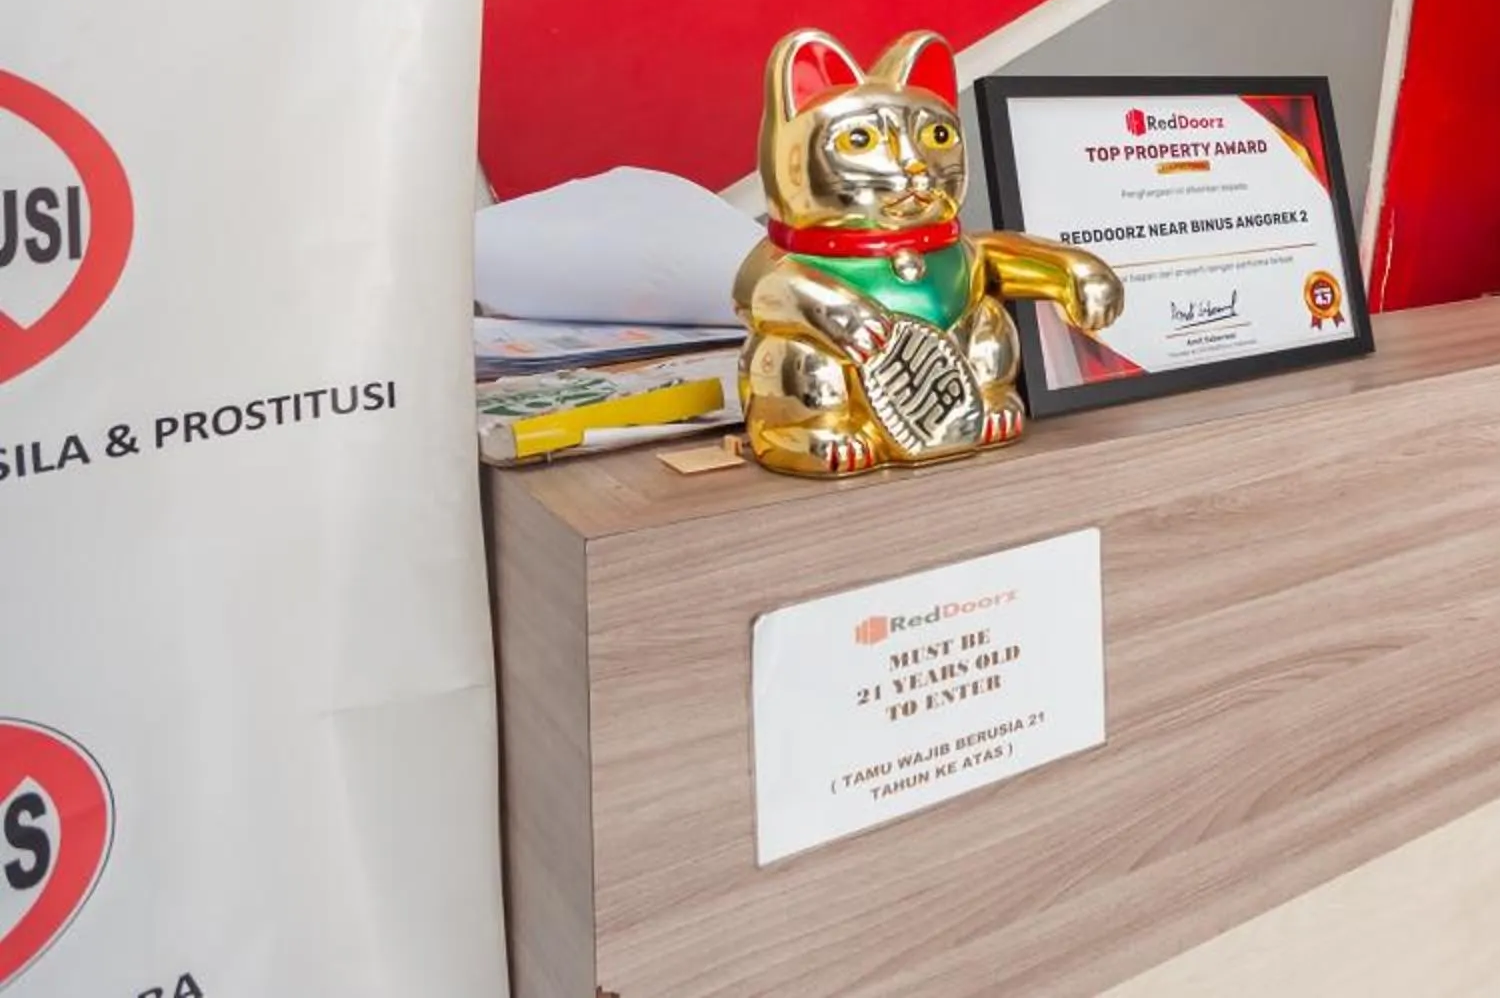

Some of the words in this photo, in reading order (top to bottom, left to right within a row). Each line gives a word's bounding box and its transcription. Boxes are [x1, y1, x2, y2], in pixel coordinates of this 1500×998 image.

[1147, 113, 1224, 131] RedDoorz
[1086, 146, 1121, 163] TOP
[1124, 141, 1211, 162] PROPERTY
[1213, 138, 1268, 156] AWARD
[1060, 224, 1147, 246] REDDOORZ
[1149, 222, 1188, 238] NEAR
[1190, 216, 1234, 233] BINUS
[1235, 209, 1299, 228] ANGGREK
[1299, 209, 1309, 224] 2
[105, 424, 140, 458] &
[154, 381, 397, 449] PROSTITUSI
[889, 589, 1019, 633] RedDoorz
[888, 639, 955, 672] MUST
[960, 628, 992, 650] BE
[856, 685, 882, 706] 21
[891, 660, 970, 695] YEARS
[975, 644, 1021, 670] OLD
[885, 699, 919, 723] TO
[926, 674, 1002, 711] ENTER
[842, 763, 893, 789] TAMU
[897, 743, 951, 771] WAJIB
[955, 719, 1025, 752] BERUSIA
[1028, 711, 1046, 728] 21
[869, 771, 930, 802] TAHUN
[934, 759, 958, 779] KE
[961, 744, 1005, 772] ATAS
